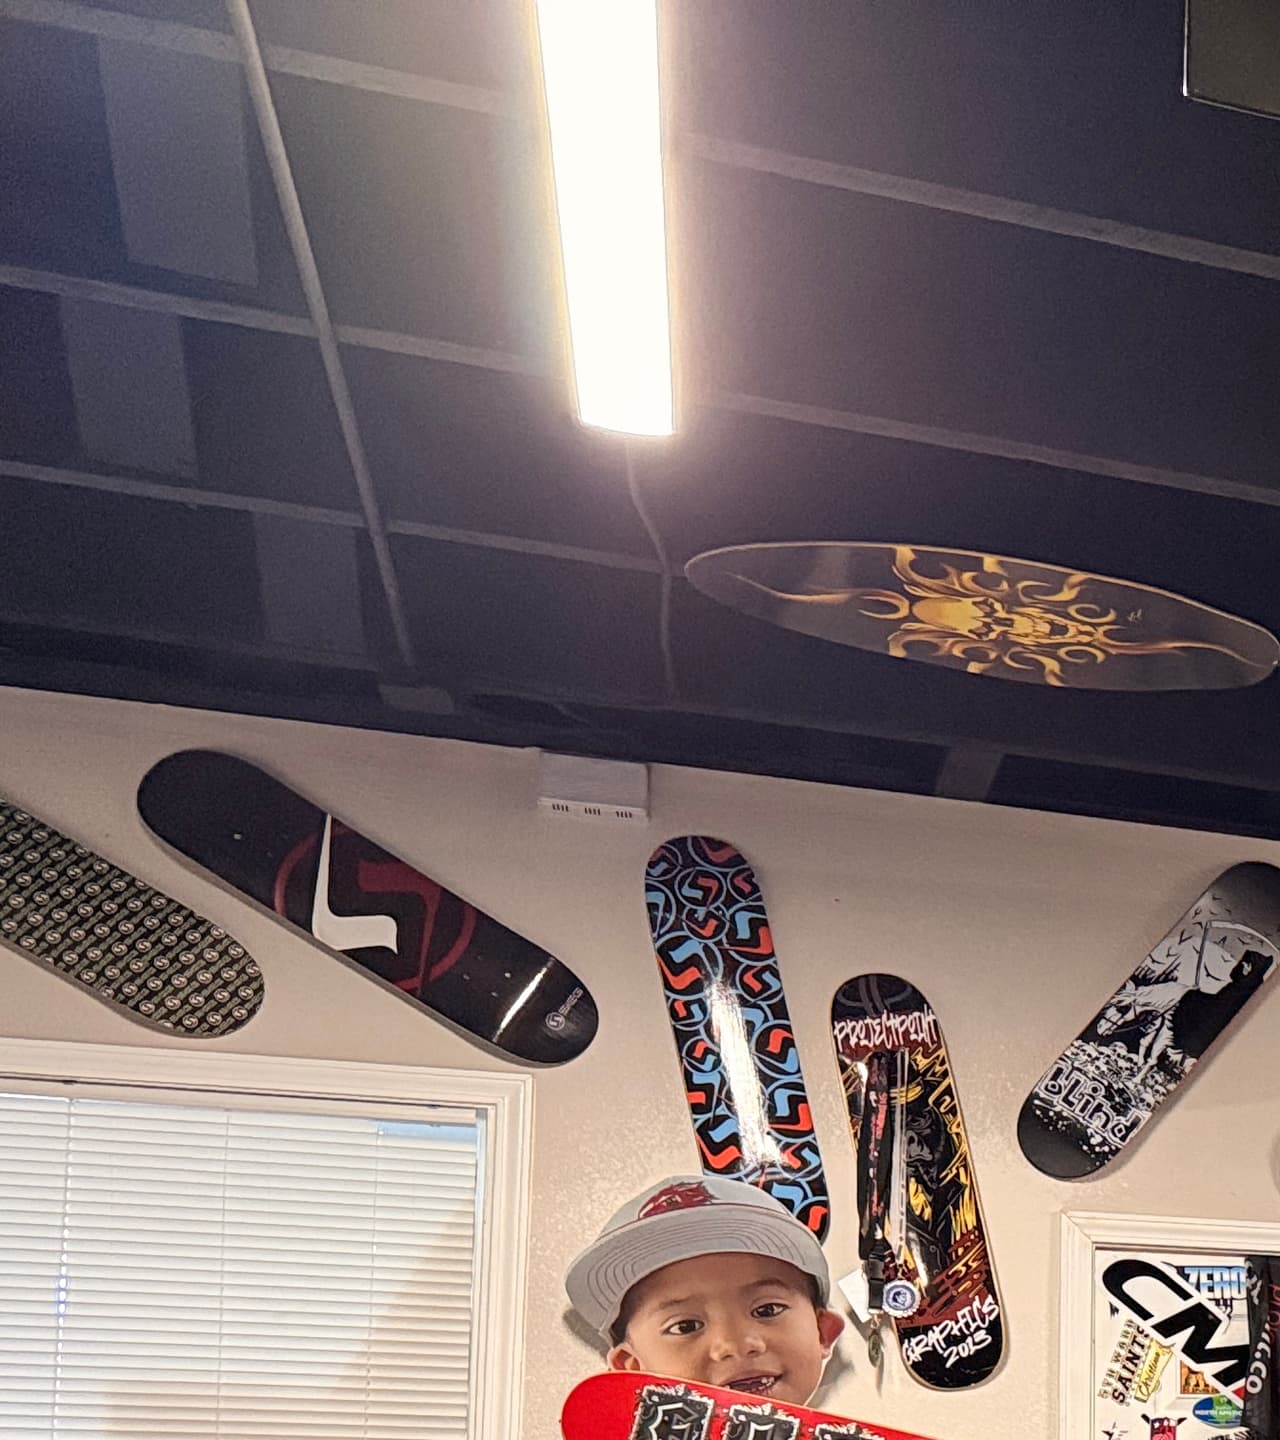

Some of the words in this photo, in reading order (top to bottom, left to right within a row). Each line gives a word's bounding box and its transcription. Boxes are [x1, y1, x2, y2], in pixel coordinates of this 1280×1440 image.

[1183, 1266, 1247, 1300] ZERO
[902, 1294, 999, 1365] GRAPHICS
[943, 1329, 992, 1369] 2013
[1111, 1325, 1150, 1404] SAINTS
